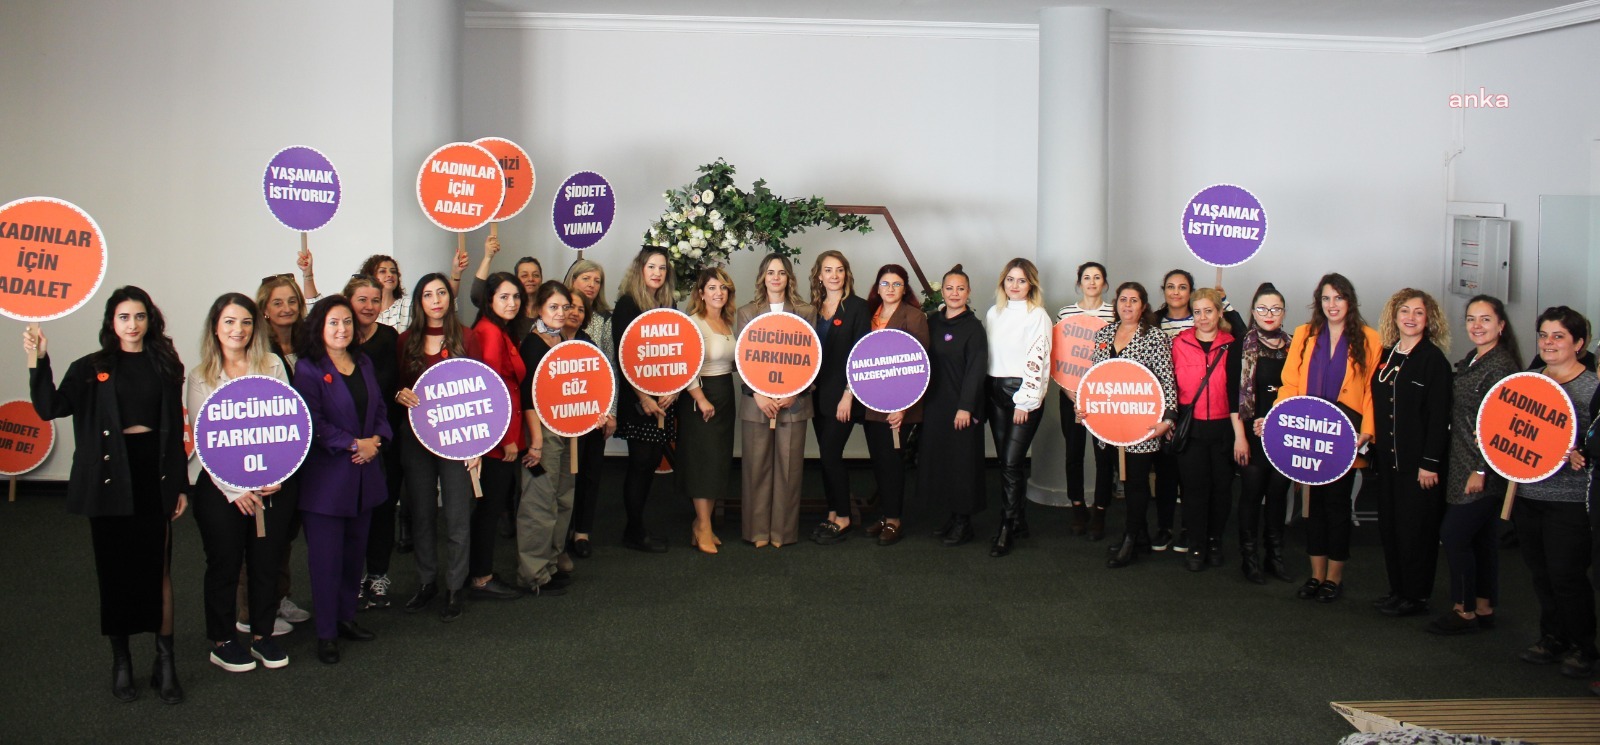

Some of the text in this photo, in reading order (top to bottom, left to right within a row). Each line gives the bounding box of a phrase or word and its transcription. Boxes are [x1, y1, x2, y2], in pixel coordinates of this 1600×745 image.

[271, 166, 333, 184] YAŞAMAK
[431, 160, 496, 180] KADINLAR
[269, 183, 335, 204] İSTİYORUZ
[447, 179, 475, 198] İÇİN
[564, 182, 607, 202] ŞİDDETE
[434, 199, 484, 217] ADALET
[574, 201, 595, 217] GÖZ
[1192, 203, 1260, 221] YAŞAMAK
[563, 221, 603, 236] YUMMA
[1188, 218, 1260, 241] İSTİYORUZ
[17, 246, 59, 273] İÇİN
[0, 276, 72, 299] ADALET
[640, 323, 680, 339] HAKLI
[747, 328, 812, 347] GÜCÜNÜN
[637, 341, 684, 362] ŞİDDET
[745, 349, 811, 367] FARKINDA
[852, 352, 923, 370] HAKLARIMIZDAN
[548, 357, 600, 380] ŞİDDETE
[634, 362, 688, 379] YOKTUR
[768, 370, 785, 384] OL
[852, 364, 926, 382] VAZGEÇMİYORUZ
[424, 375, 487, 401] KADINA
[562, 378, 588, 397] GÖZ
[1086, 382, 1154, 399] YAŞAMAK
[207, 395, 298, 422] GÜCÜNÜN
[426, 398, 494, 428] ŞİDDETE
[550, 400, 600, 420] YUMMA
[1085, 398, 1156, 415] İSTİYORUZ
[1498, 386, 1569, 430] KADINLAR
[0, 419, 40, 438] İDDETE
[1278, 413, 1342, 436] SESİMİZİ
[1508, 413, 1540, 442] İÇİN
[206, 424, 301, 449] FARKINDA
[438, 423, 491, 447] HAYIR
[1283, 433, 1335, 455] SEN DE
[15, 440, 35, 454] DE!
[1489, 433, 1543, 469] ADALET
[243, 453, 268, 472] OL
[1291, 454, 1323, 472] DUY
